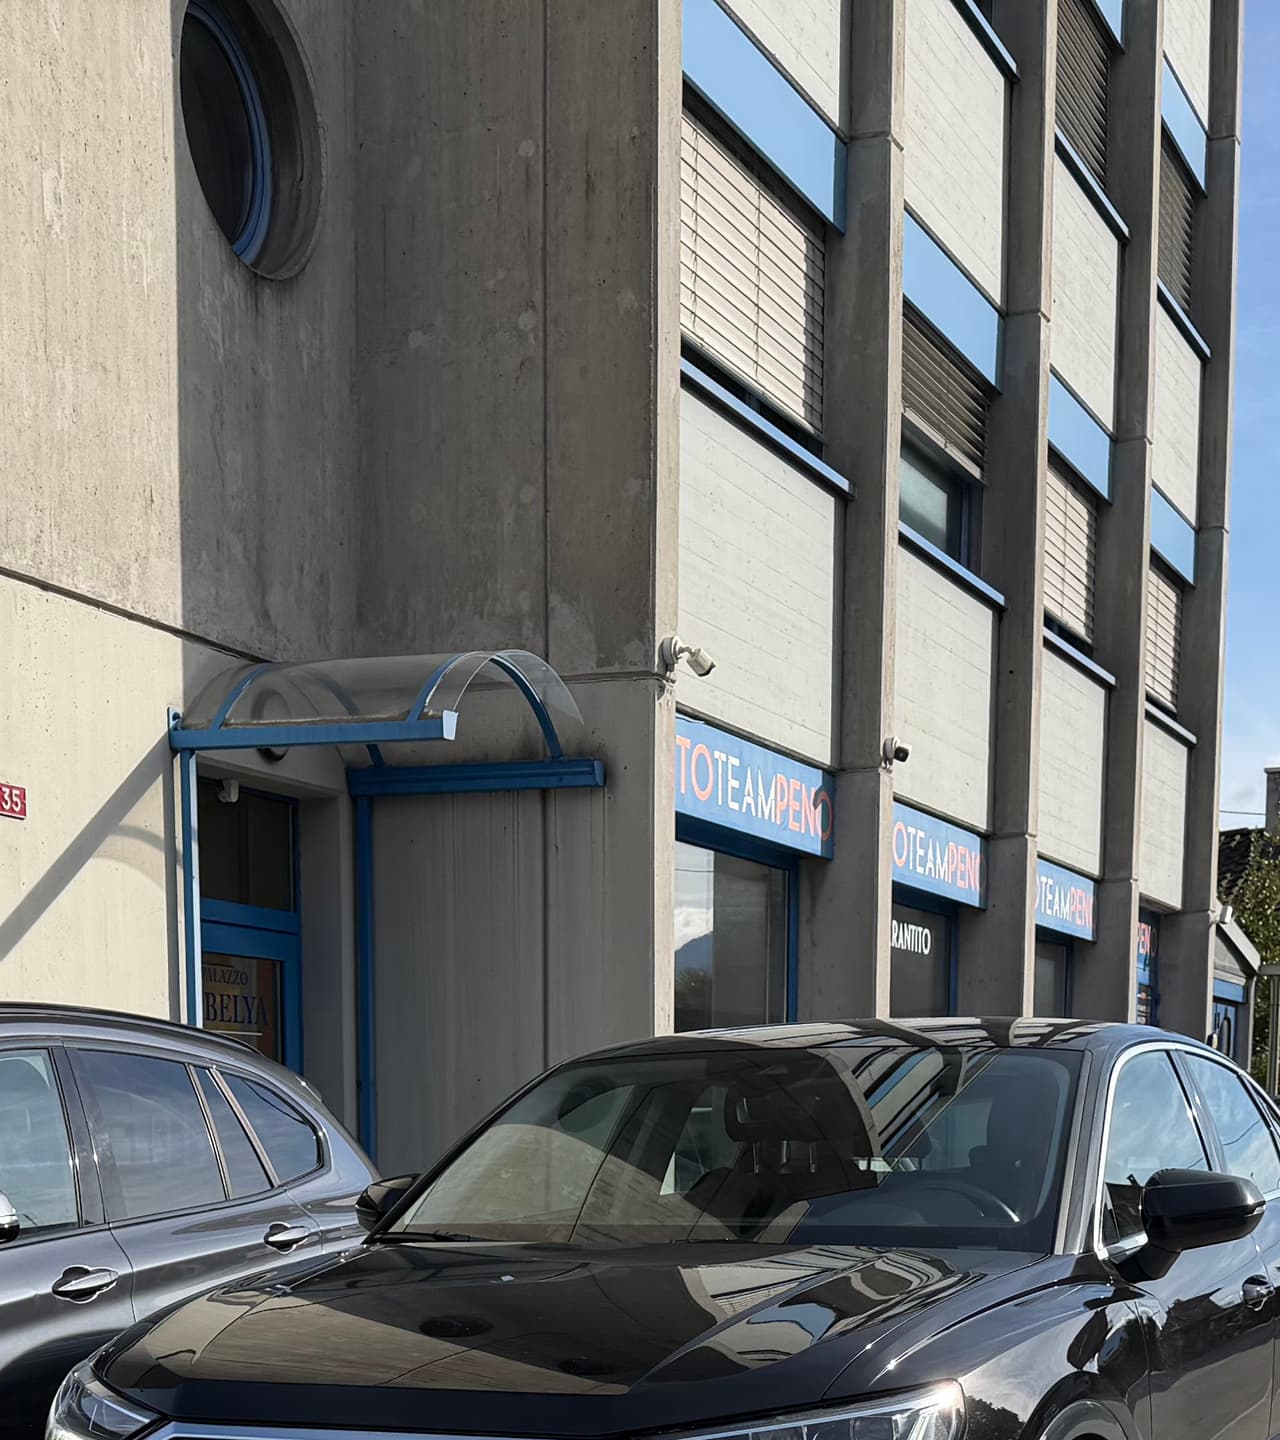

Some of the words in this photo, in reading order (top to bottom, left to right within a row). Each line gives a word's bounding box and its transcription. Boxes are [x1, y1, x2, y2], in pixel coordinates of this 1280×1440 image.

[2, 787, 21, 812] 35
[676, 735, 834, 841] TOTEAMPENO
[891, 919, 932, 955] RANTITO
[202, 967, 248, 986] ALAZZO
